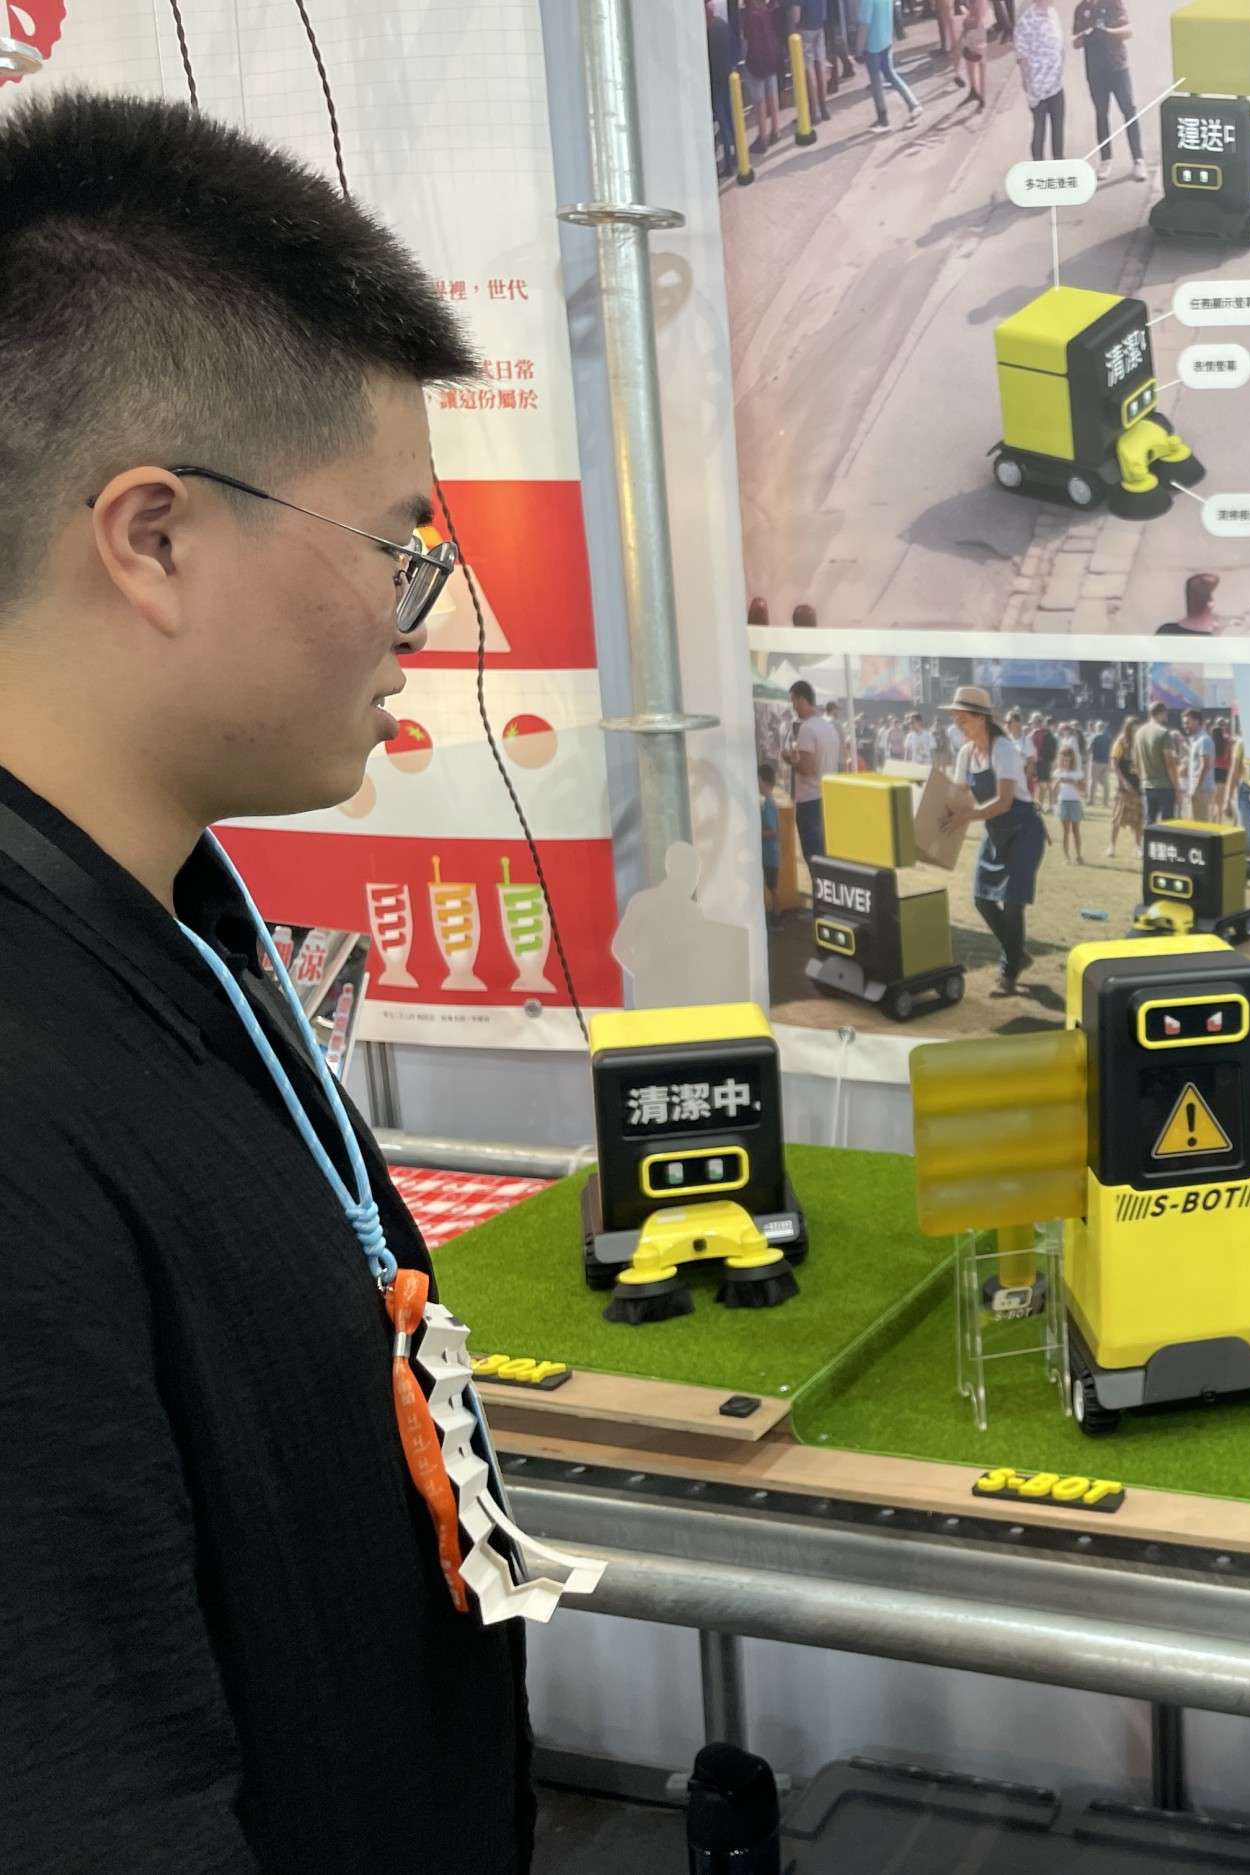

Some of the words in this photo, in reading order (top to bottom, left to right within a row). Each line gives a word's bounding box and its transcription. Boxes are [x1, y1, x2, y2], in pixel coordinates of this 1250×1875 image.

[1105, 330, 1147, 387] 清潔
[1150, 1186, 1242, 1218] S-BOT
[977, 1467, 1123, 1505] S-BOT
